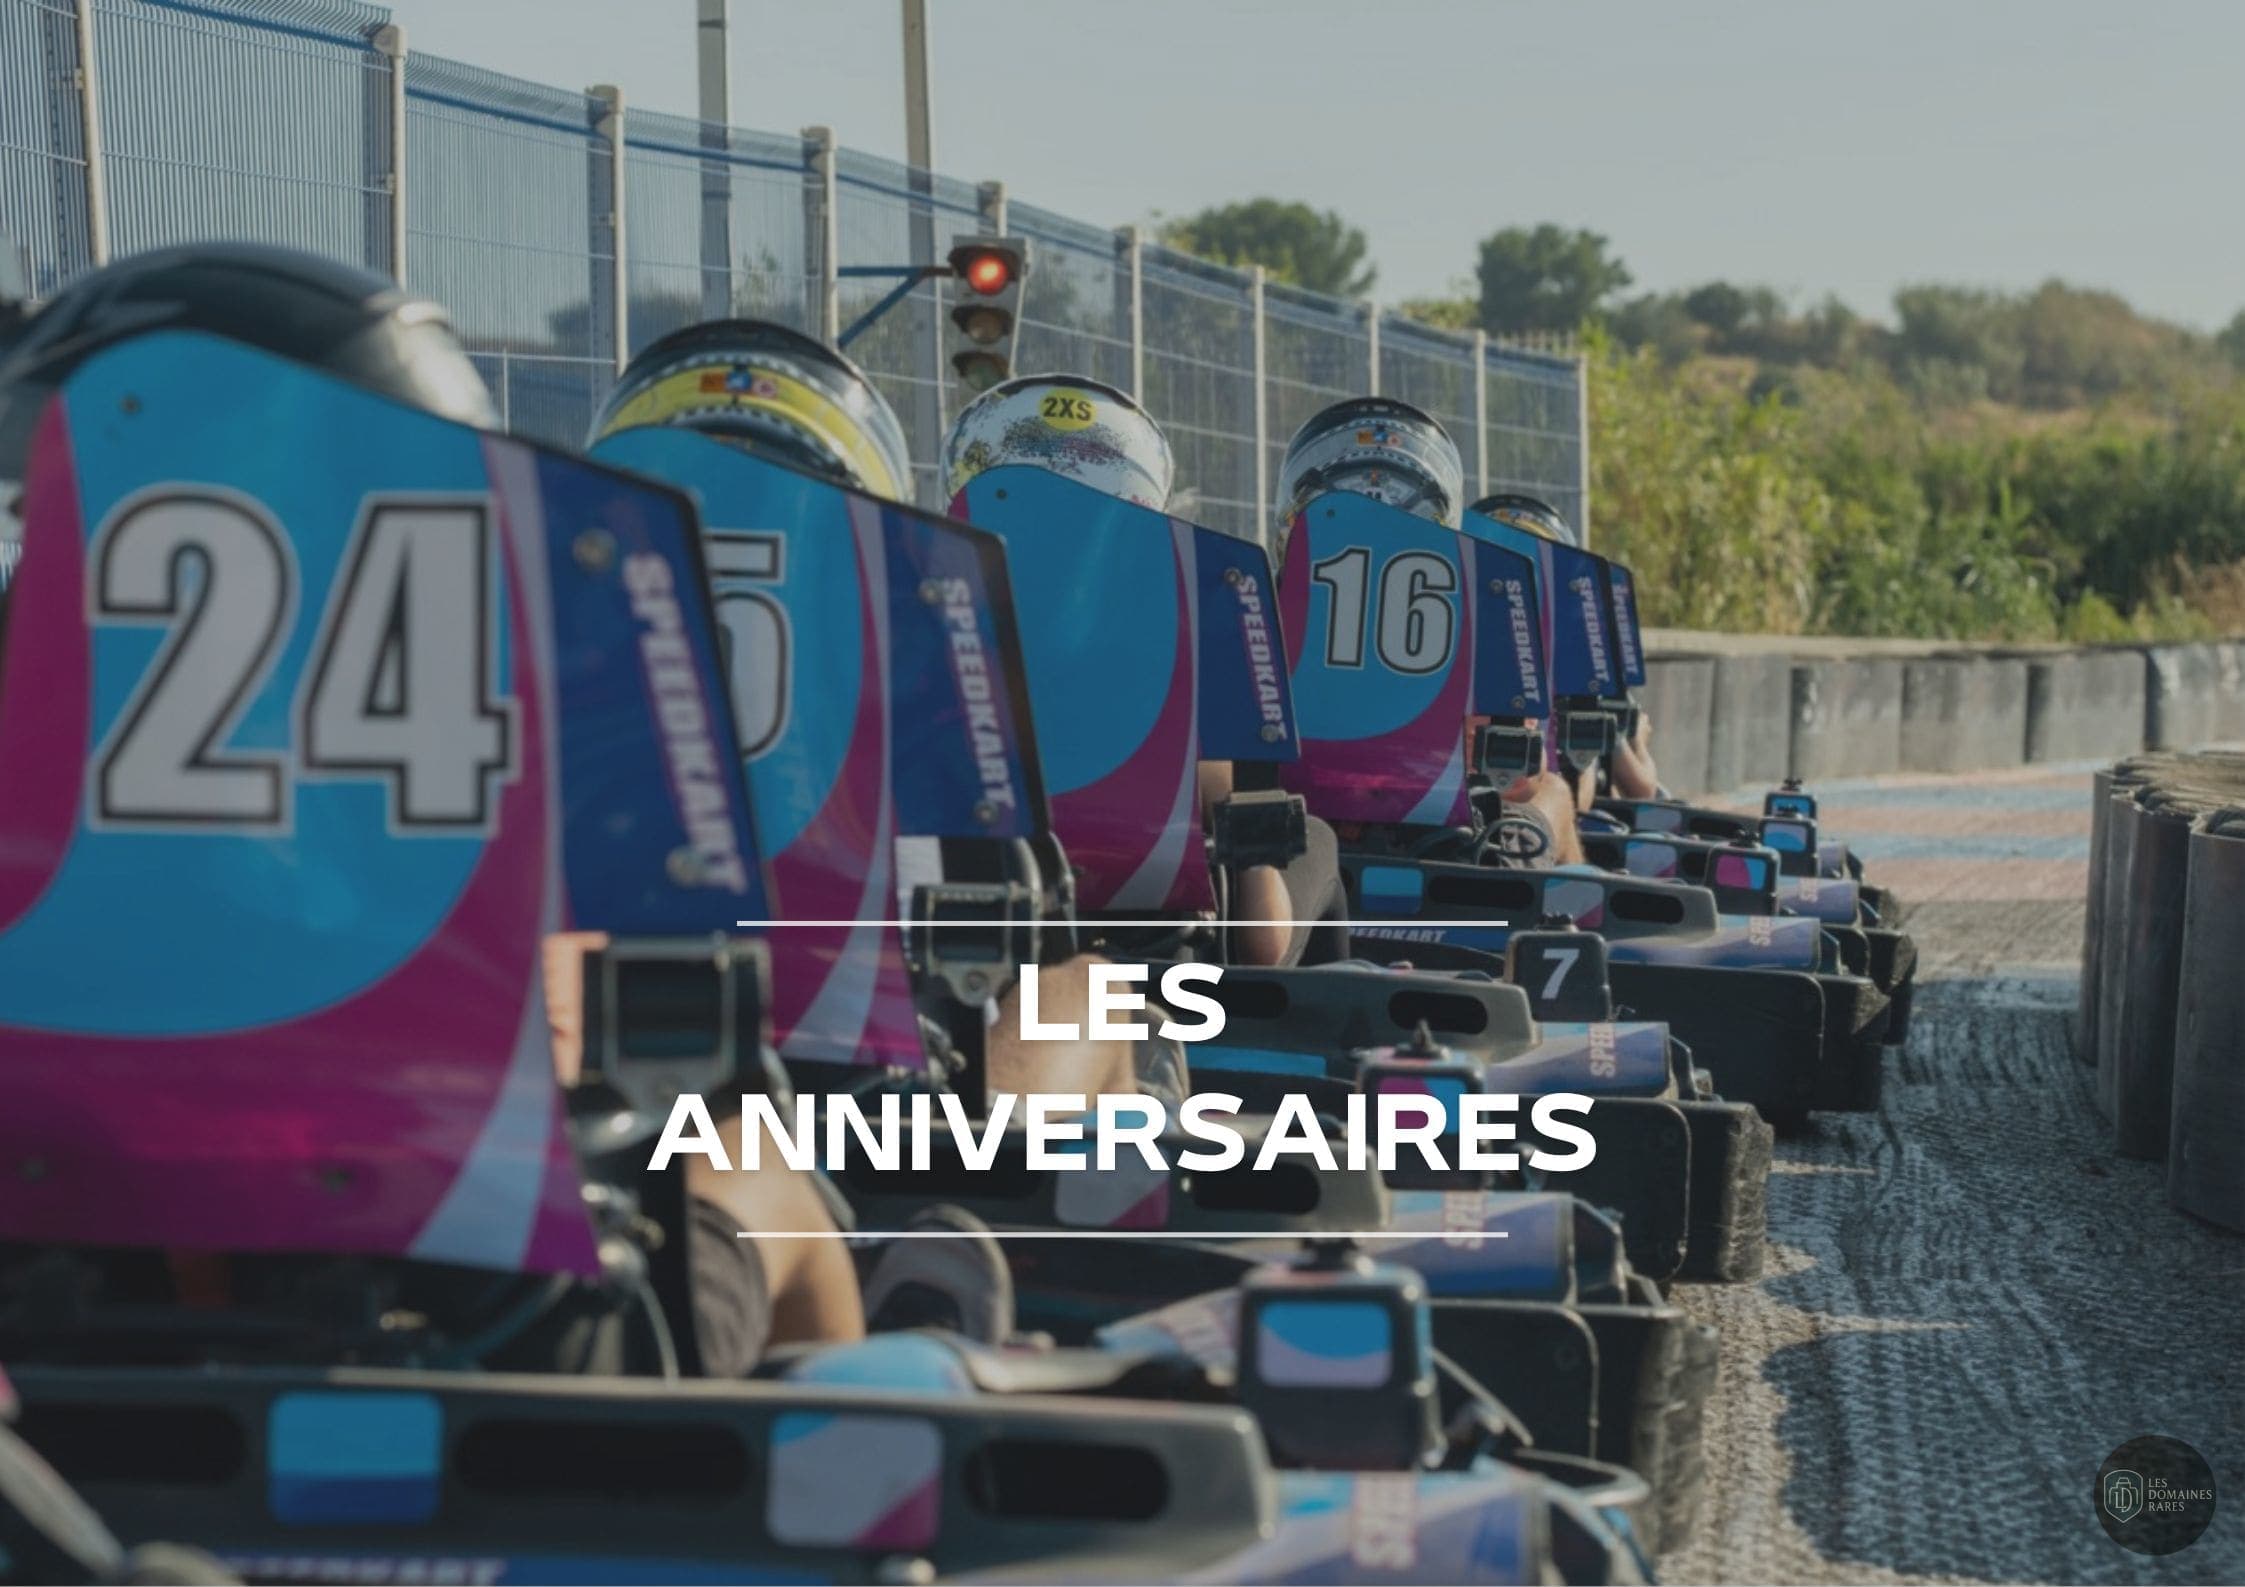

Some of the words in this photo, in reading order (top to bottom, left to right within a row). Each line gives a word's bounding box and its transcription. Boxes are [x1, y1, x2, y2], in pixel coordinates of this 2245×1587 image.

[1043, 396, 1092, 421] 2XS
[88, 484, 522, 837] 24
[1311, 545, 1459, 676] 16
[1505, 579, 1541, 703] SPEEDKART
[942, 576, 1016, 809] SPEEDKART
[1541, 948, 1580, 1000] 7
